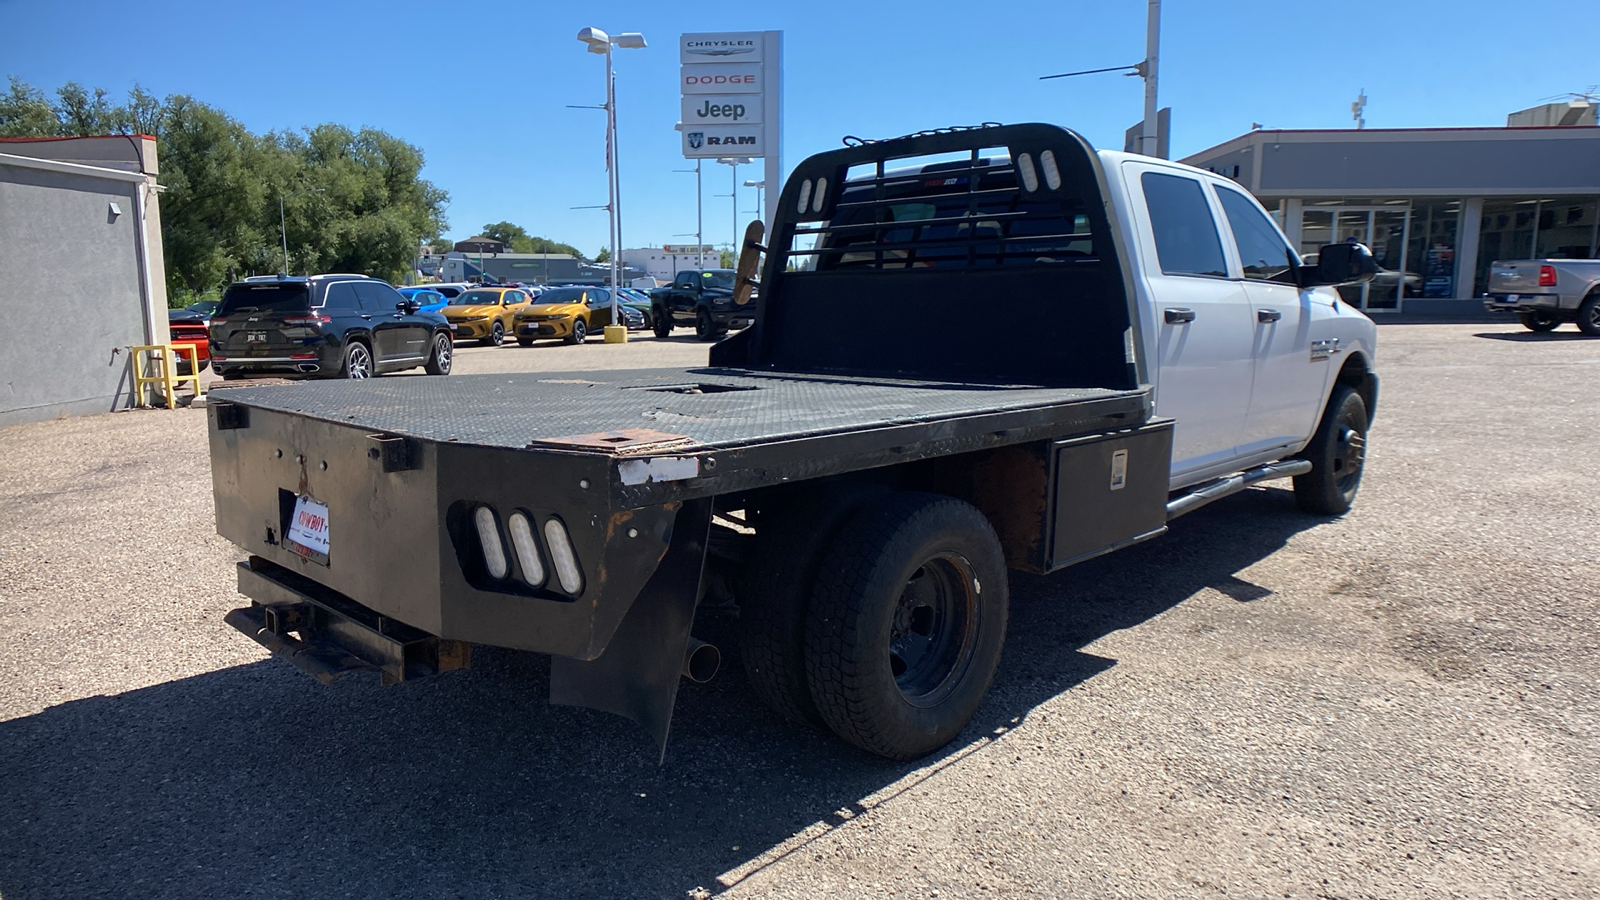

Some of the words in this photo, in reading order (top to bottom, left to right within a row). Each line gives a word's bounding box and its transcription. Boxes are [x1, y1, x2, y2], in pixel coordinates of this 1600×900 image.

[686, 75, 755, 85] DODGE
[697, 100, 745, 120] Jeep
[707, 136, 756, 145] RAM
[299, 511, 325, 532] COWBOY
